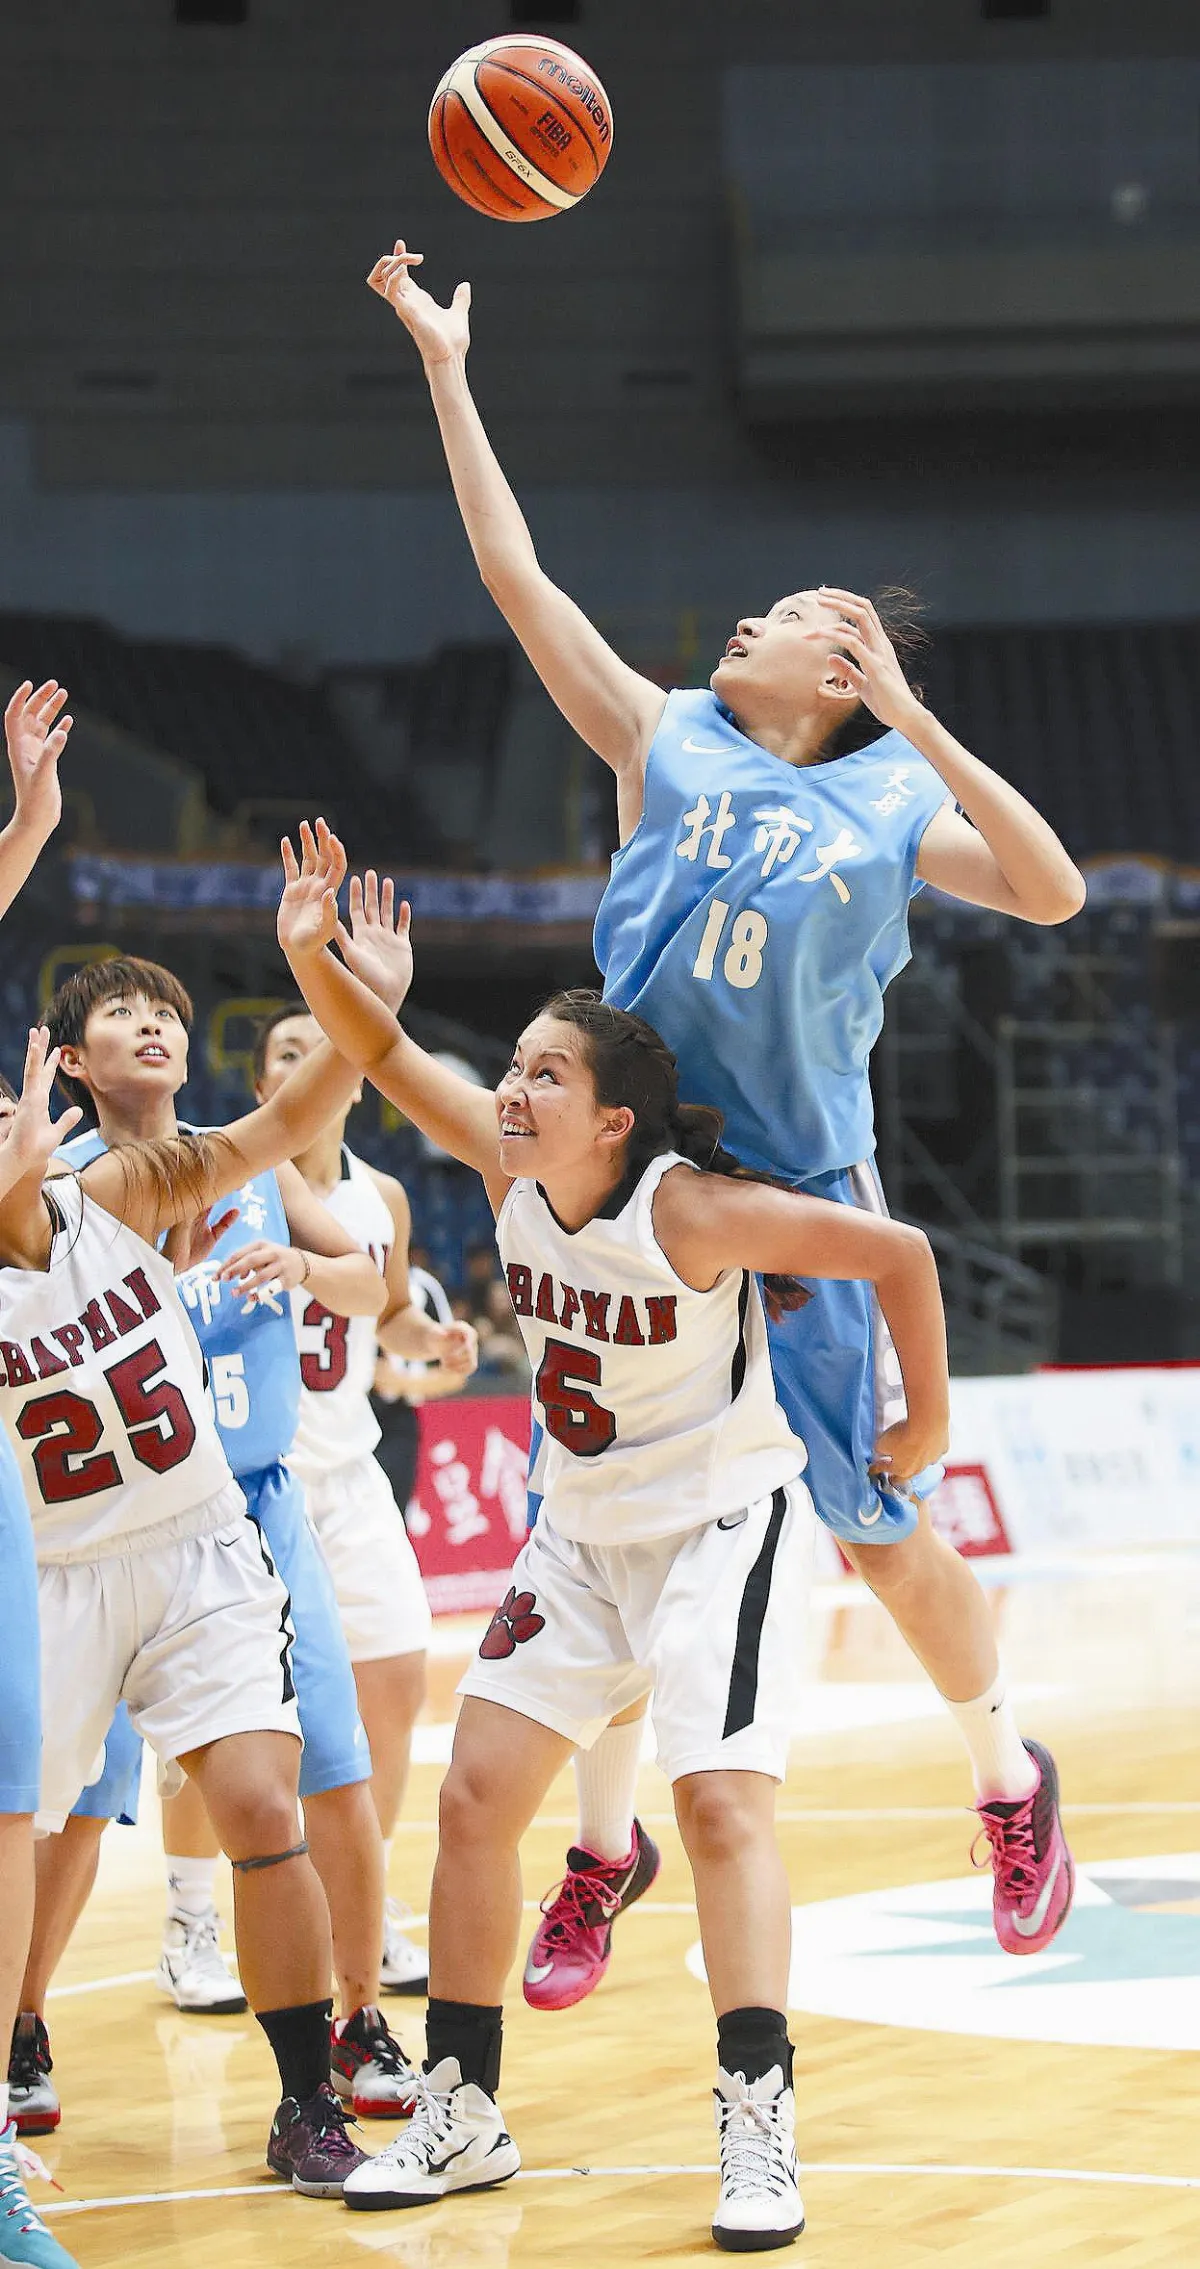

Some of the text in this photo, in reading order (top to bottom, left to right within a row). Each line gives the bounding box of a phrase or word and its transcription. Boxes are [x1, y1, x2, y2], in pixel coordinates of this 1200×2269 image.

[537, 110, 573, 151] FIBA
[538, 58, 609, 144] molten
[675, 791, 863, 905] 北市大
[692, 899, 768, 989] 18
[299, 1299, 350, 1392] 3
[506, 1263, 677, 1346] HAPMAN
[15, 1337, 196, 1505] 25
[204, 1353, 250, 1430] 5
[536, 1337, 618, 1457] 5
